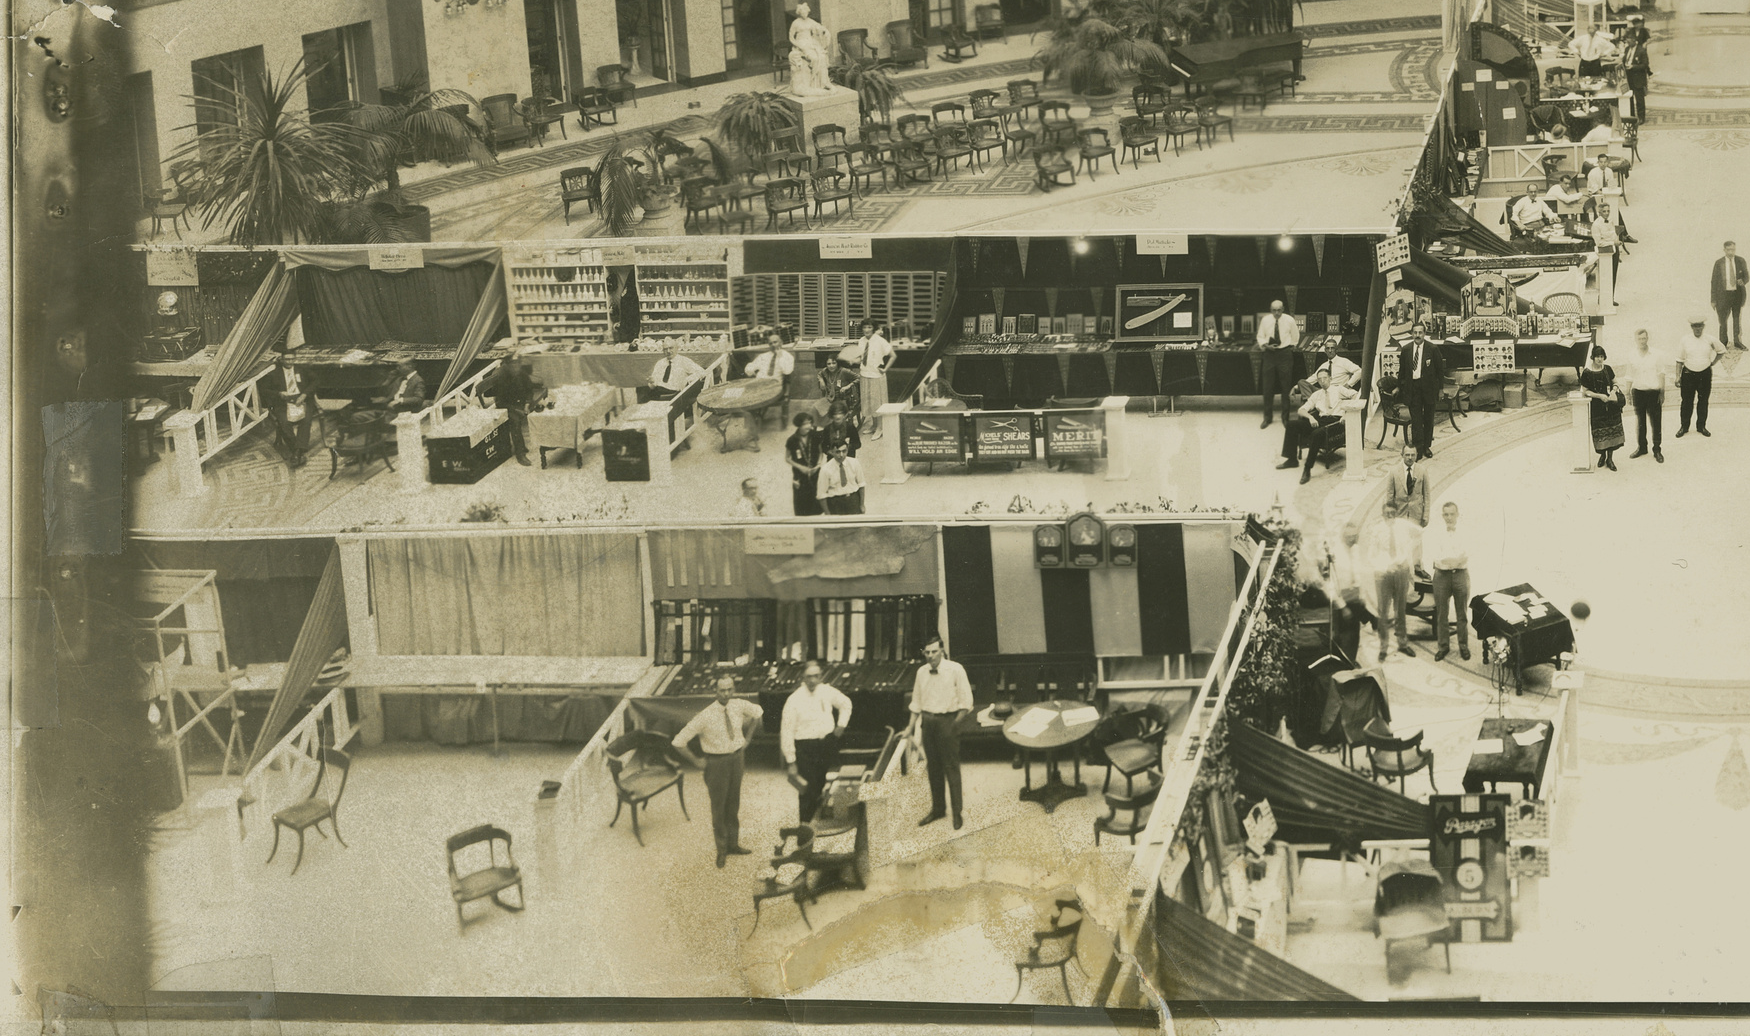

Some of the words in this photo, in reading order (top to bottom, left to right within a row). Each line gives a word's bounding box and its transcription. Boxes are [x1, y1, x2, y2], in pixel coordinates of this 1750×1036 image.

[484, 428, 499, 444] GLSS
[1003, 431, 1031, 441] SHEARS
[1052, 431, 1097, 442] MERIT
[1443, 816, 1497, 834] Paragon
